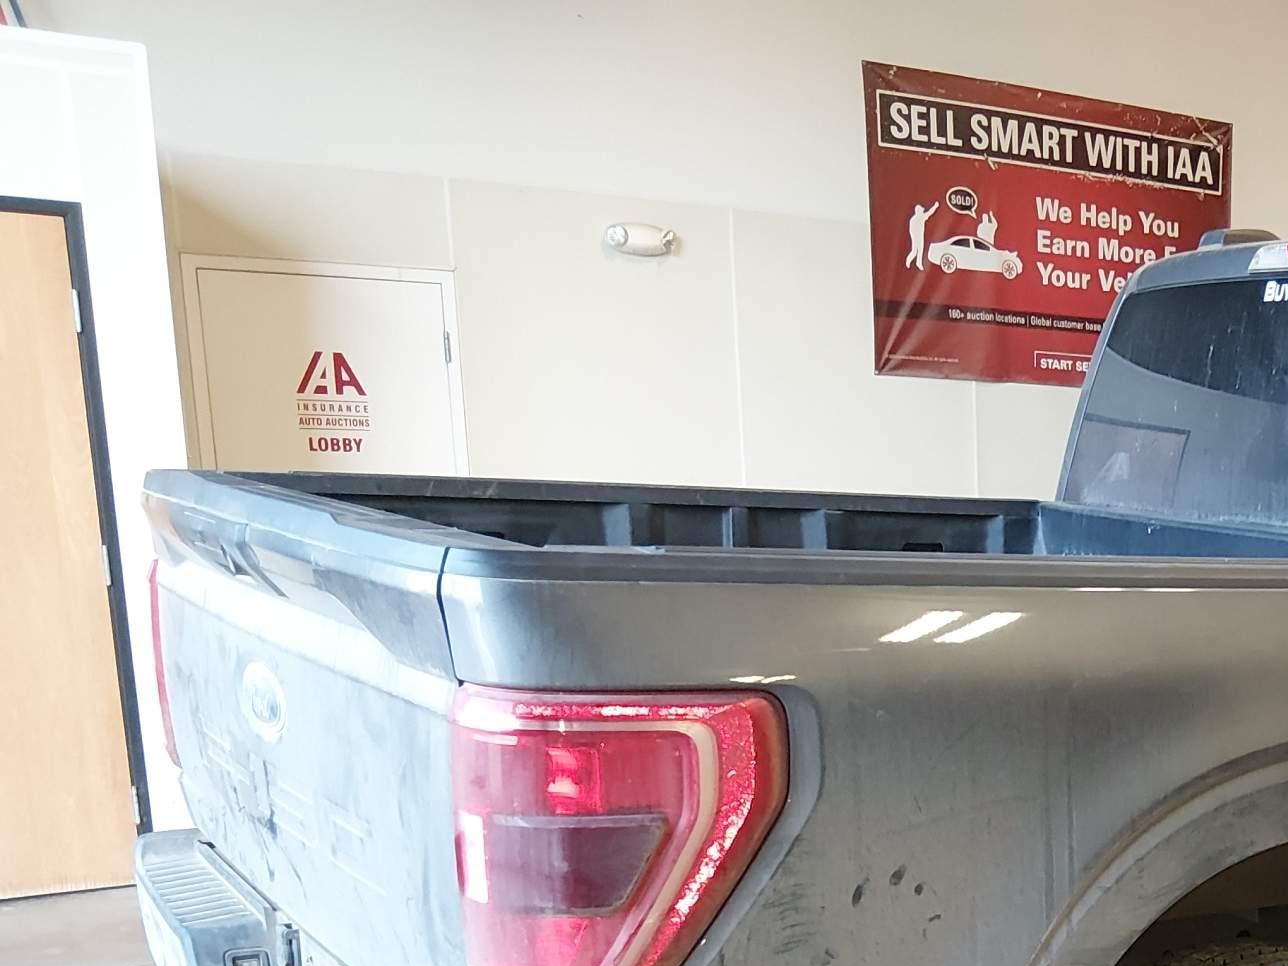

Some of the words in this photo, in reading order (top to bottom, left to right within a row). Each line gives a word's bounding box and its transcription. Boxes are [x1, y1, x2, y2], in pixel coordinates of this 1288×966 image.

[889, 102, 963, 147] SELL
[970, 113, 1079, 163] SMART
[1084, 132, 1159, 178] WITH
[1166, 146, 1214, 185] IAA
[950, 194, 974, 207] SOLD!
[1035, 196, 1073, 223] We
[1080, 202, 1133, 236] Help
[1137, 210, 1180, 238] You
[1036, 229, 1090, 258] Earn
[1098, 237, 1157, 264] More
[1035, 261, 1091, 290] Your
[1098, 268, 1133, 293] Ve
[948, 308, 965, 320] 160+
[966, 311, 995, 321] auction
[995, 312, 1026, 325] locations
[1030, 315, 1052, 327] Global
[1053, 319, 1085, 331] customer
[1085, 320, 1102, 332] base
[1040, 357, 1074, 371] START
[297, 402, 369, 414] INSURANCE
[298, 416, 323, 427] AUTO
[325, 417, 370, 428] AUCTIONS
[308, 436, 363, 453] LOBBY
